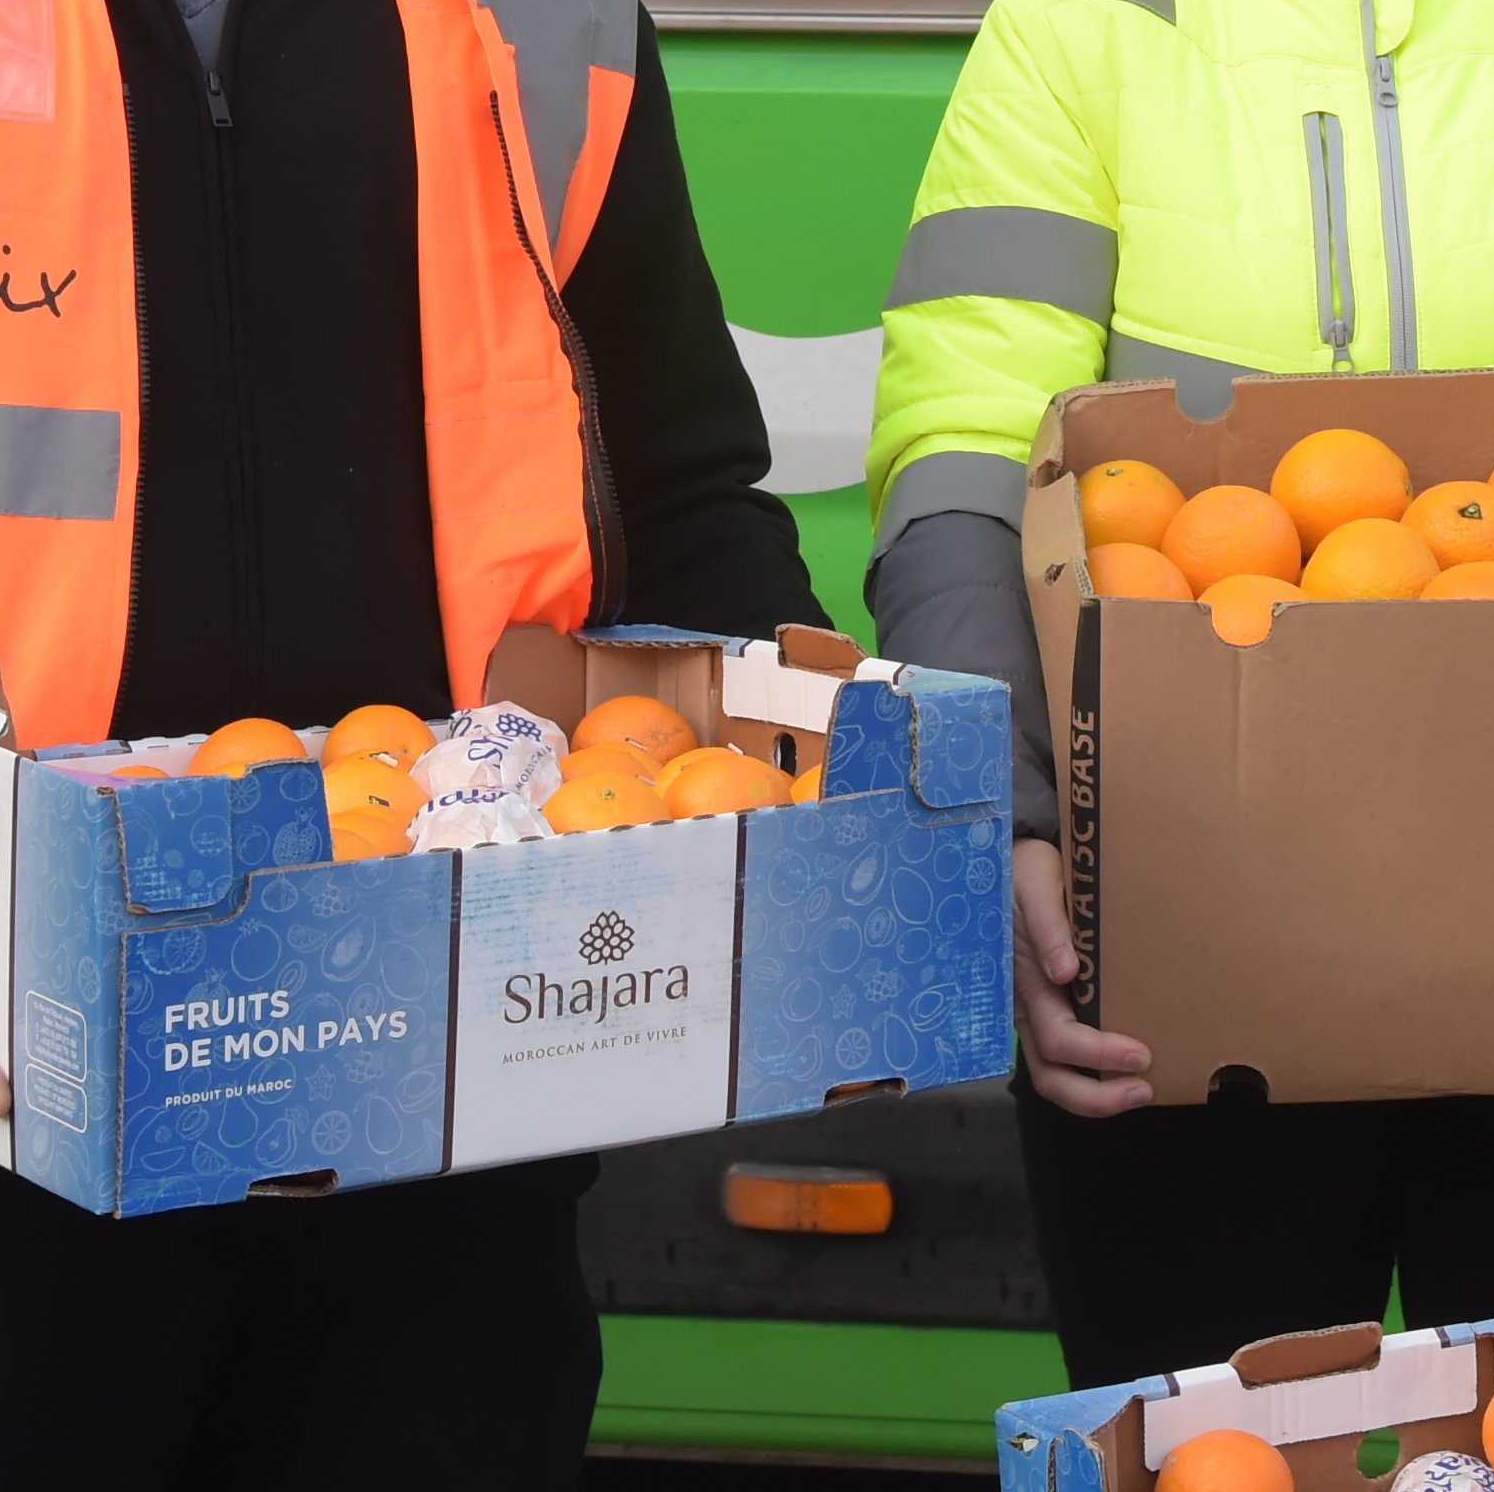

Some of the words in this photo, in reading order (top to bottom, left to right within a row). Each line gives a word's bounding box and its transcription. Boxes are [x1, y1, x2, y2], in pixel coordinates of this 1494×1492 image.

[1070, 705, 1095, 809] BASE
[165, 990, 290, 1034] FRUITS
[504, 964, 689, 1025] Shajara
[164, 1038, 212, 1072] DE
[224, 1024, 305, 1063] MON
[318, 1010, 408, 1049] PAYS
[503, 1042, 586, 1065] MOROCCAN
[591, 1037, 617, 1052] ART
[623, 1033, 641, 1046] DE
[647, 1026, 688, 1042] VIVRE
[165, 1088, 221, 1108] PRODUIT
[225, 1086, 244, 1099] DU
[247, 1079, 293, 1095] MAROC
